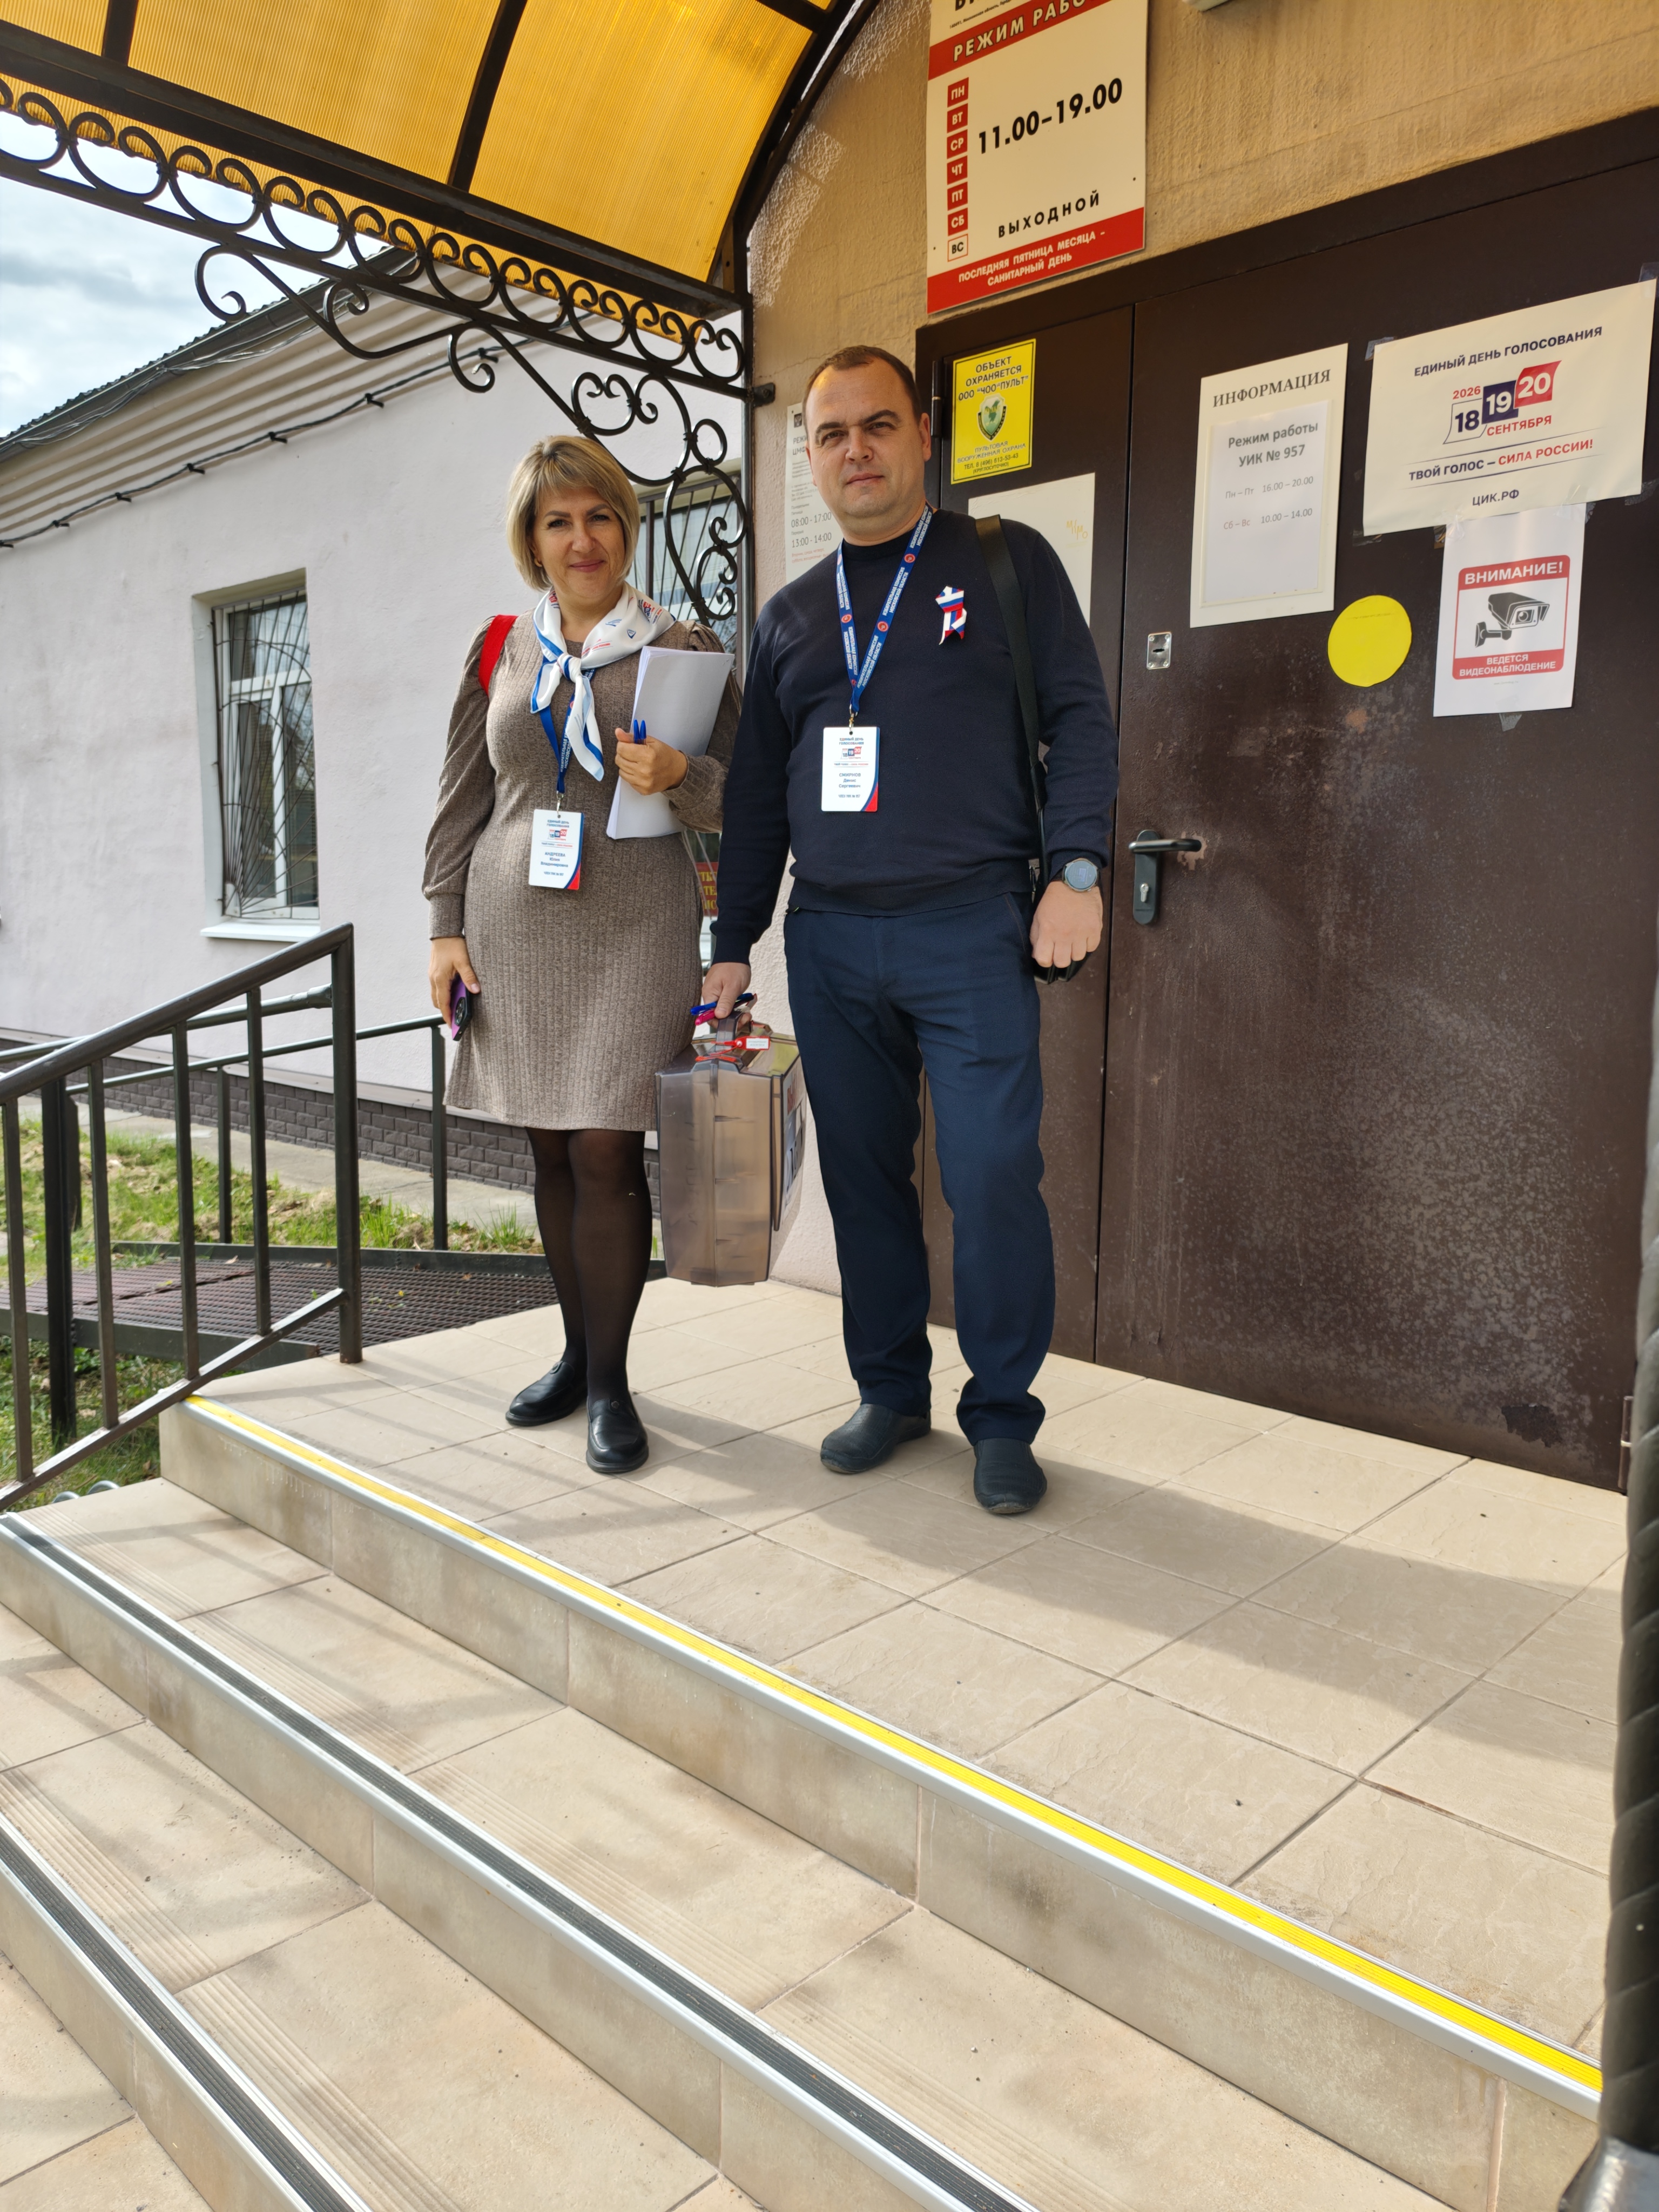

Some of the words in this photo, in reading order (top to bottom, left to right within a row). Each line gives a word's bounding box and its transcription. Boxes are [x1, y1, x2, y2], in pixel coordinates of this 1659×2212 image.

[953, 15, 1024, 63] РЕЖИМ
[951, 85, 965, 100] ПН
[952, 111, 963, 125] ВТ
[950, 137, 964, 151] СР
[951, 163, 963, 176] ЧТ
[952, 189, 964, 203] ПТ
[951, 214, 965, 228] СБ
[998, 189, 1100, 239] ВЫХОДНОЙ
[952, 241, 964, 254] ВС
[958, 258, 1009, 283] ПОСЛЕДНЯЯ
[1013, 244, 1054, 266] ПЯТНИЦА
[1057, 231, 1096, 251] МЕСЯЦА
[987, 259, 1044, 286] САНИТАРНЫЙ
[1048, 253, 1073, 268] ДЕНЬ
[1414, 355, 1465, 377] ЕДИНЫЙ
[1468, 349, 1501, 367] ДЕНЬ
[1504, 326, 1603, 357] ГОЛОСОВАНИЯ
[976, 356, 1011, 373] ОБЪЕКТ
[966, 365, 1022, 387] ОХРАНЯЕТСЯ
[1517, 372, 1551, 399] 20
[958, 389, 975, 401] ООО
[1213, 369, 1331, 408] ИНФОРМАЦИЯ
[1452, 385, 1481, 400] 2026
[1486, 392, 1512, 416] 19
[1454, 409, 1480, 433] 18
[1486, 415, 1552, 437] СЕНТЯБРЯ
[1229, 431, 1270, 449] Режим
[1272, 423, 1318, 442] работы
[957, 449, 1000, 463] ВООРУЖЕННАЯ
[1002, 443, 1026, 453] ОХРАНА
[1239, 453, 1263, 468] УИК
[1266, 450, 1280, 462] №
[1284, 444, 1306, 459] 957
[1408, 465, 1441, 481] ТВОЙ
[1444, 459, 1485, 476] ГОЛОС
[1498, 451, 1532, 466] СИЛА
[1535, 439, 1594, 459] РОССИИ!
[1225, 490, 1236, 499] Пн
[1244, 487, 1254, 495] Пт
[1262, 482, 1283, 493] 16.00
[1292, 476, 1313, 488] 20.00
[1472, 489, 1520, 506] ЦИК.РФ
[791, 516, 809, 528] 08:00
[814, 511, 832, 523] 17:00
[1223, 521, 1233, 529] Сб
[1261, 512, 1282, 524] 10.00
[1291, 508, 1313, 519] 14.00
[792, 536, 809, 548] 13:00
[814, 532, 832, 543] 14:00
[899, 572, 908, 588] ОБЛАСТИ
[1465, 561, 1563, 585] ВНИМАНИЕ!
[882, 587, 897, 616] ИЗБИРАТЕЛЬНАЯ
[894, 567, 905, 587] КОМИССИЯ
[857, 656, 871, 688] ИЗБИРАТЕЛЬНАЯ
[867, 636, 879, 656] КОМИССИЯ
[862, 660, 875, 687] МОСКОВСКОЙ
[873, 643, 882, 660] ОБЛАСТИ
[1460, 661, 1556, 677] ВИДЕОНАБЛЮДЕНИЕ
[1487, 654, 1528, 665] ВЕДЕТСЯ
